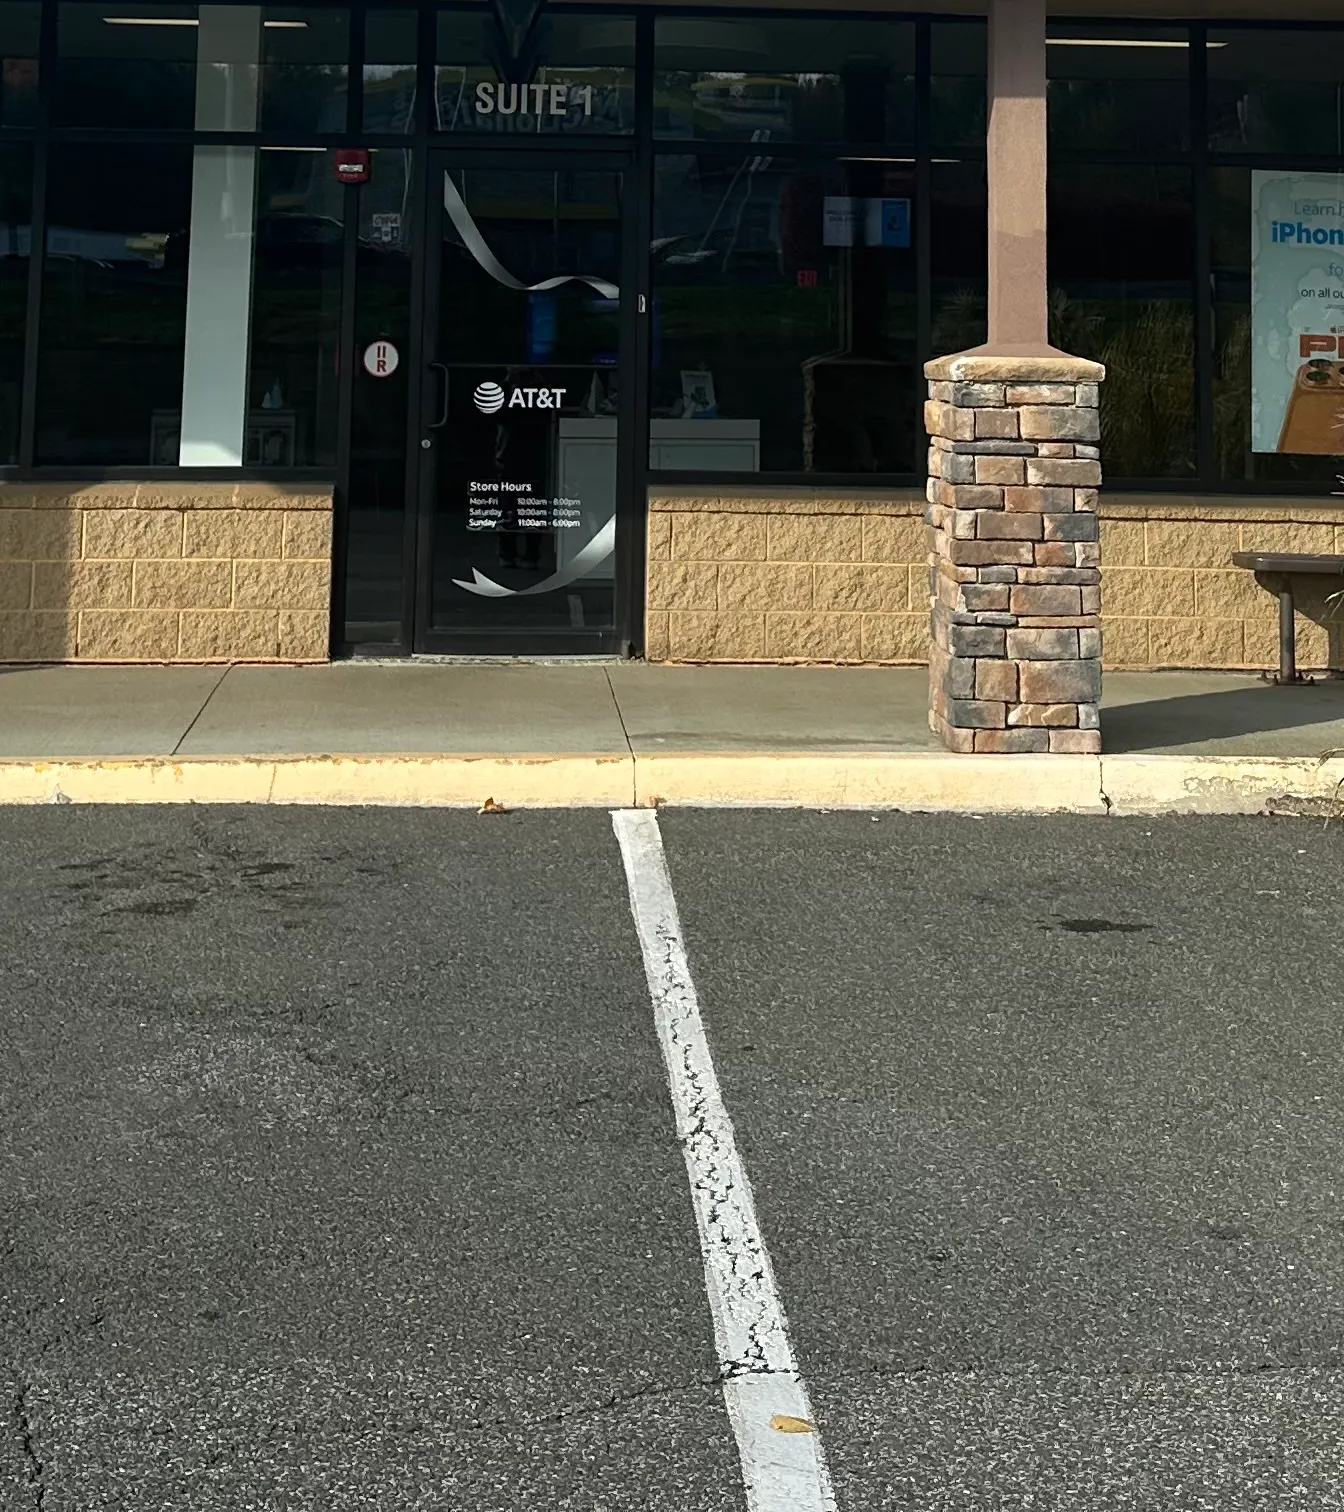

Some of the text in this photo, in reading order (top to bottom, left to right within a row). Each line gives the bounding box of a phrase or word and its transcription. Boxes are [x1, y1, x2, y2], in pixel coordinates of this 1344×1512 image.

[474, 81, 592, 116] SUITE 1
[1294, 202, 1335, 216] Learn
[1301, 288, 1316, 298] on
[1318, 287, 1330, 298] all
[377, 359, 387, 373] R
[508, 387, 567, 409] AT&T
[469, 481, 532, 492] Store Hours
[469, 507, 503, 517] Saturday
[468, 518, 497, 528] Sunday
